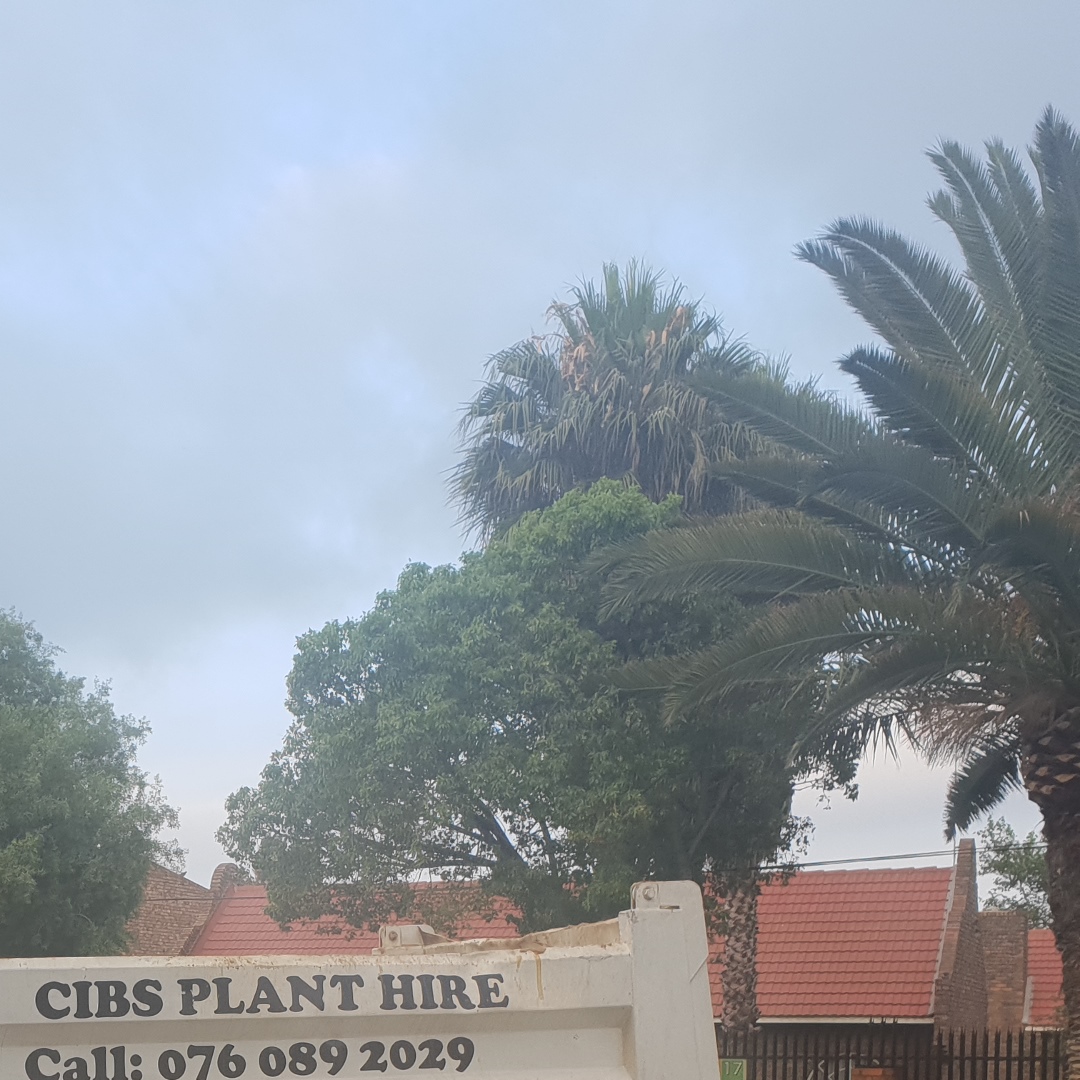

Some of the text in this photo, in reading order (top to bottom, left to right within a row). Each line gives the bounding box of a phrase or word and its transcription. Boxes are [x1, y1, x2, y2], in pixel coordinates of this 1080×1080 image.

[35, 973, 510, 1020] CIBS PLANT HIRE
[258, 1040, 348, 1078] 089
[359, 1036, 475, 1073] 2029
[724, 1061, 742, 1075] 17
